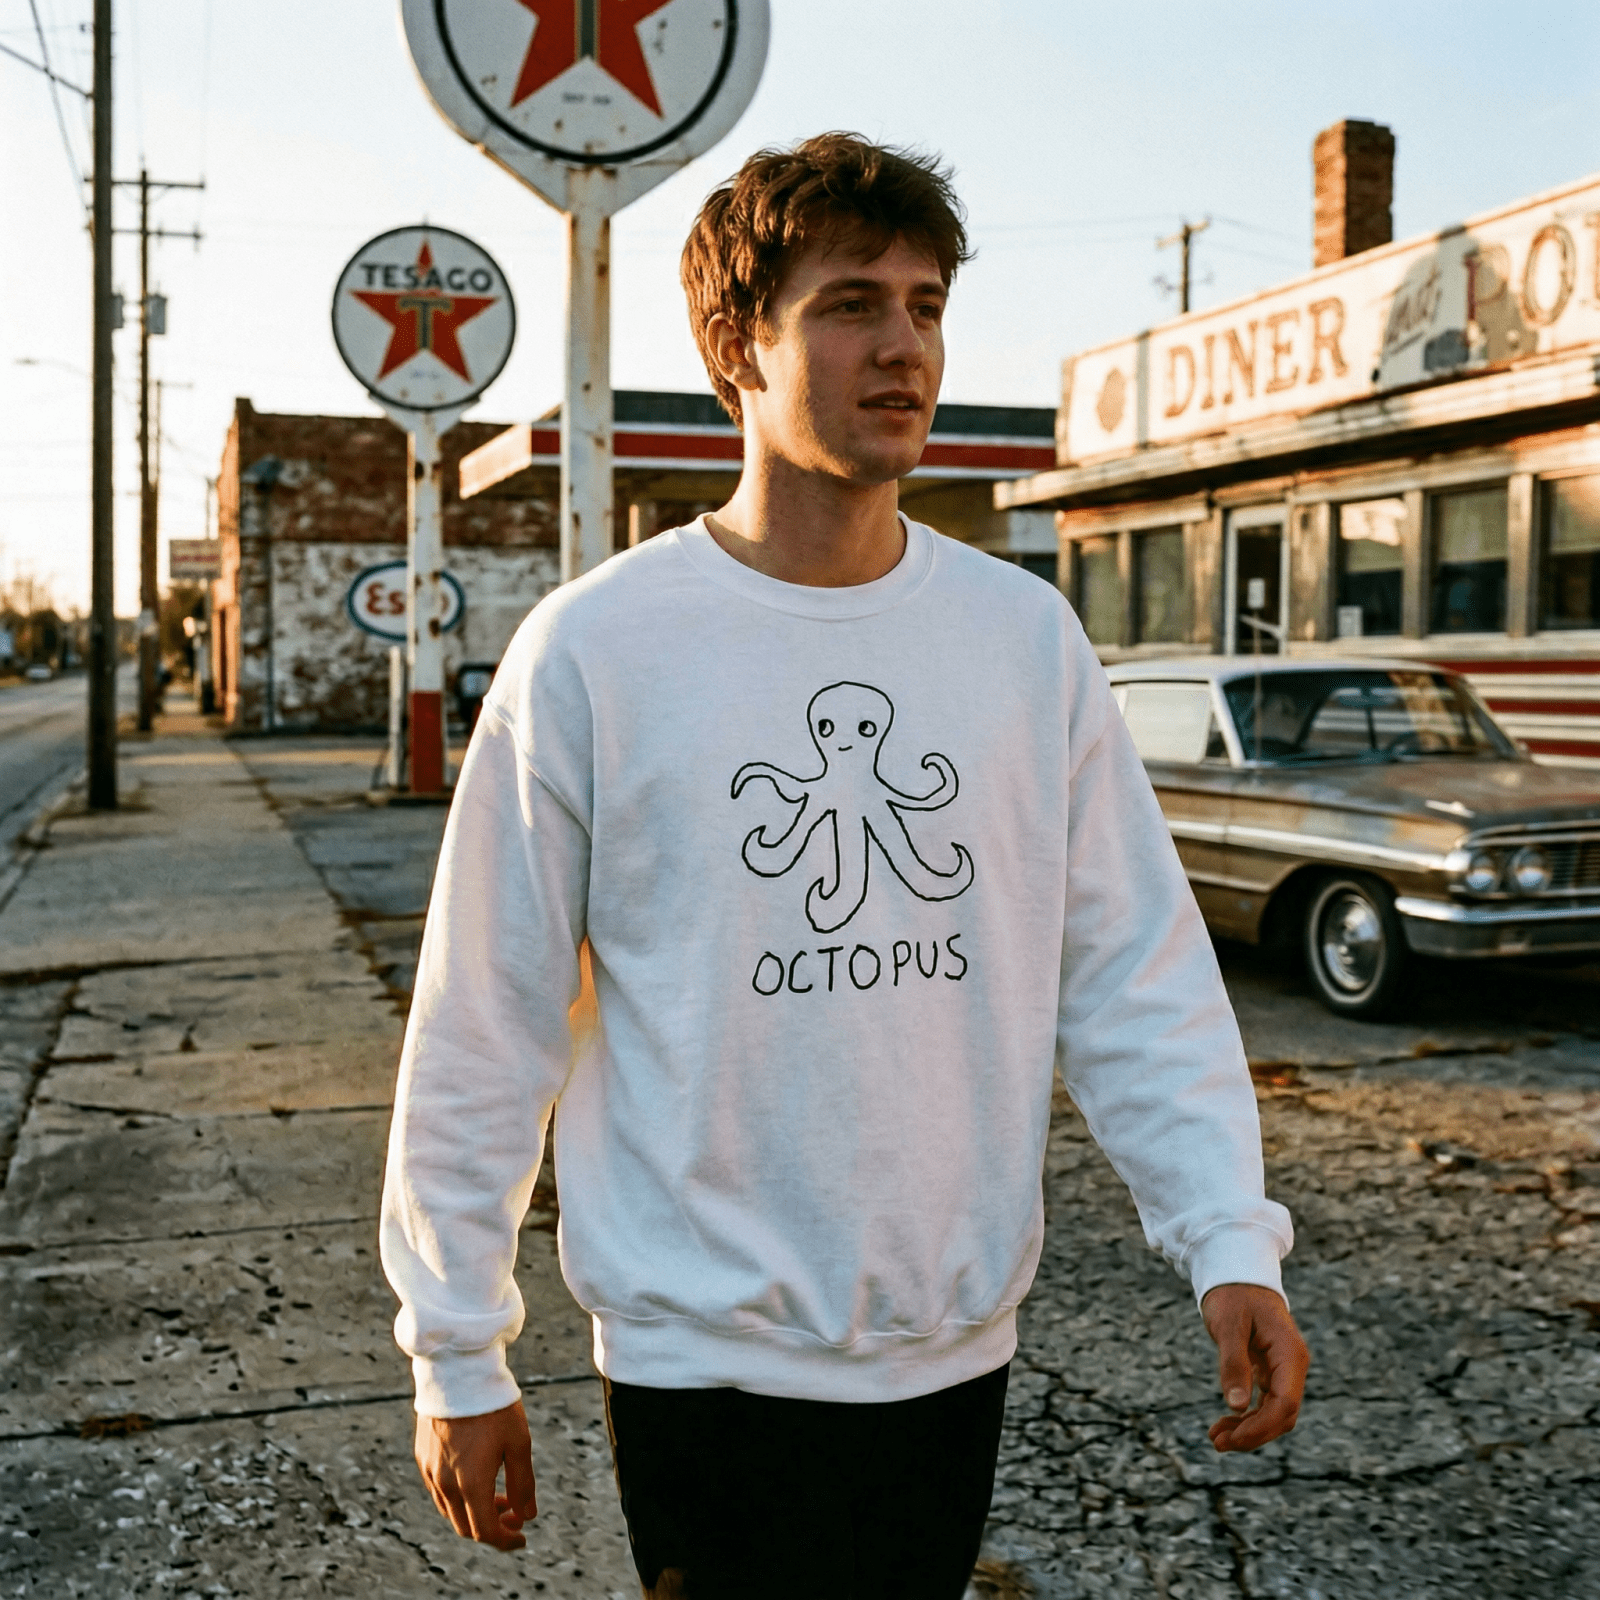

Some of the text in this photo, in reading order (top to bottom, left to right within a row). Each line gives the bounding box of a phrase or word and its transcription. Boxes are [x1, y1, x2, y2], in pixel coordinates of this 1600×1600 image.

[399, 295, 453, 350] T
[1164, 297, 1348, 419] DINER
[752, 933, 968, 996] OCTOPUS
